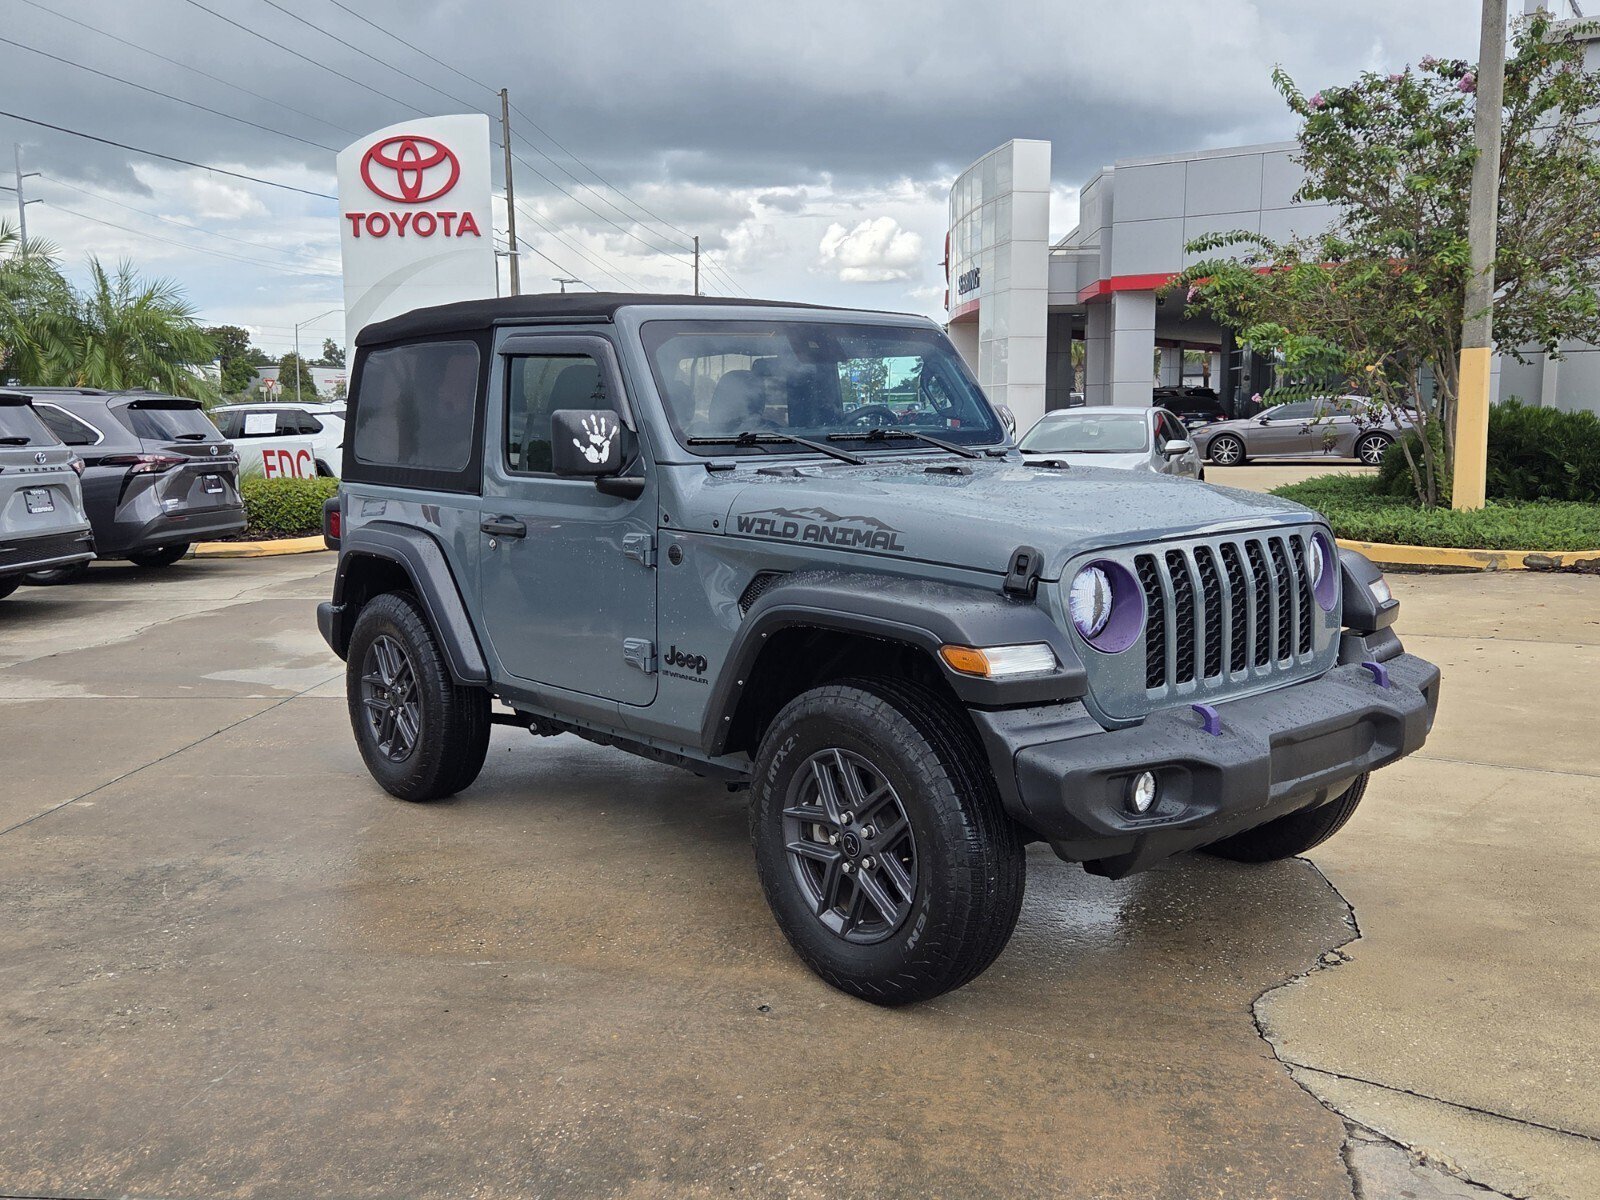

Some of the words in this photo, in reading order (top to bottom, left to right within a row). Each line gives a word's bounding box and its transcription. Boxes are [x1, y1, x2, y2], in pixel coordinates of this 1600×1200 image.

[345, 211, 481, 237] TOYOTA
[737, 515, 799, 539] WILD
[802, 523, 905, 551] ANIMAL
[664, 644, 708, 675] Jeep
[669, 672, 709, 685] WRANGLER
